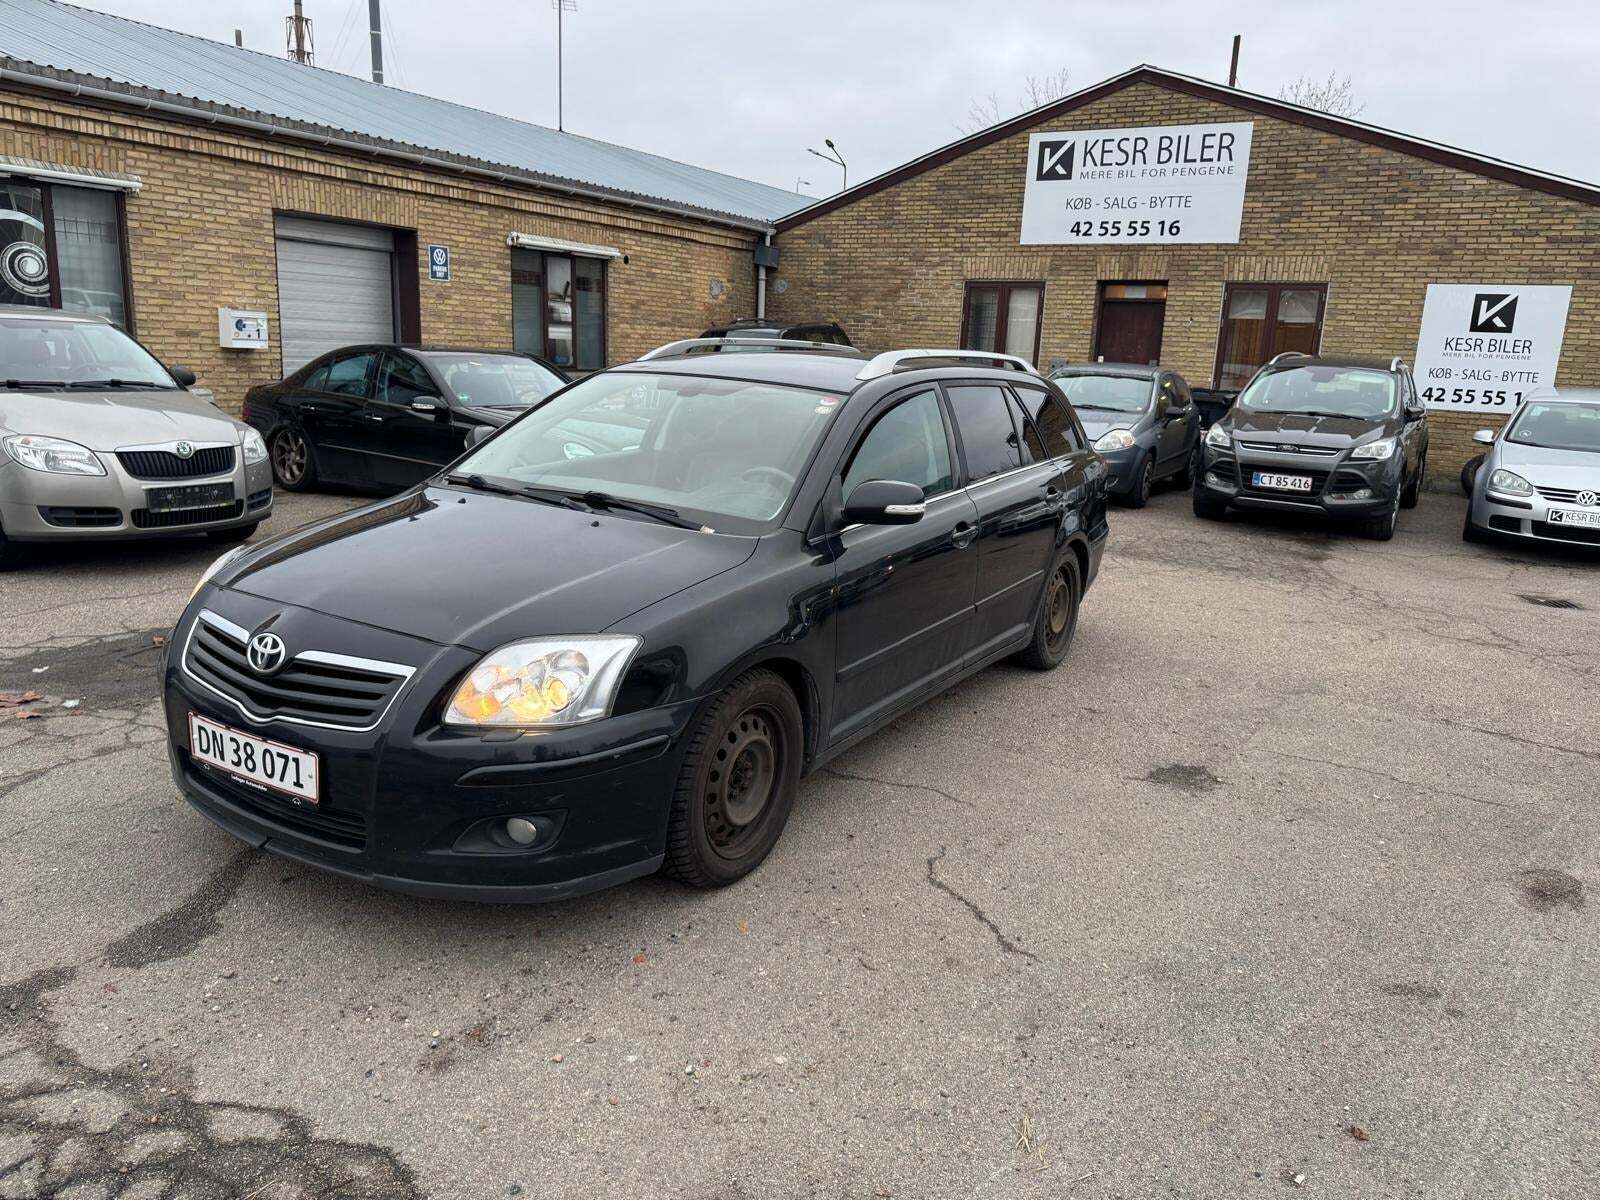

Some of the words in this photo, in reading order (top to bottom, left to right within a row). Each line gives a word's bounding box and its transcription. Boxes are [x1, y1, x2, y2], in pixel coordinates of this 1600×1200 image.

[1083, 137, 1149, 167] KESR
[1157, 132, 1235, 165] BILER
[1080, 170, 1113, 180] MERE
[1117, 169, 1136, 179] BIL
[1141, 168, 1167, 178] FOR
[1171, 165, 1234, 177] PENGENE
[1065, 197, 1092, 210] KØB
[1103, 196, 1137, 209] SALG
[1149, 195, 1192, 209] BYTTE
[1070, 221, 1093, 236] 42
[1098, 221, 1121, 236] 55
[1127, 220, 1150, 236] 55
[1158, 220, 1181, 236] 16
[256, 328, 260, 339] 1
[1444, 337, 1484, 352] KESR
[1487, 339, 1533, 354] BILER
[1428, 368, 1452, 379] KØB
[1461, 369, 1492, 381] SALG
[1501, 370, 1540, 383] BYTTE
[1422, 387, 1446, 402] 42
[1451, 388, 1476, 404] 55
[1481, 390, 1506, 406] 55
[1514, 391, 1523, 407] 1
[1260, 475, 1275, 486] CT
[1276, 476, 1288, 487] 85
[1290, 478, 1310, 489] 416
[1566, 512, 1588, 522] KESR
[197, 724, 225, 762] DN
[230, 736, 257, 773] 38
[262, 748, 304, 789] 071
